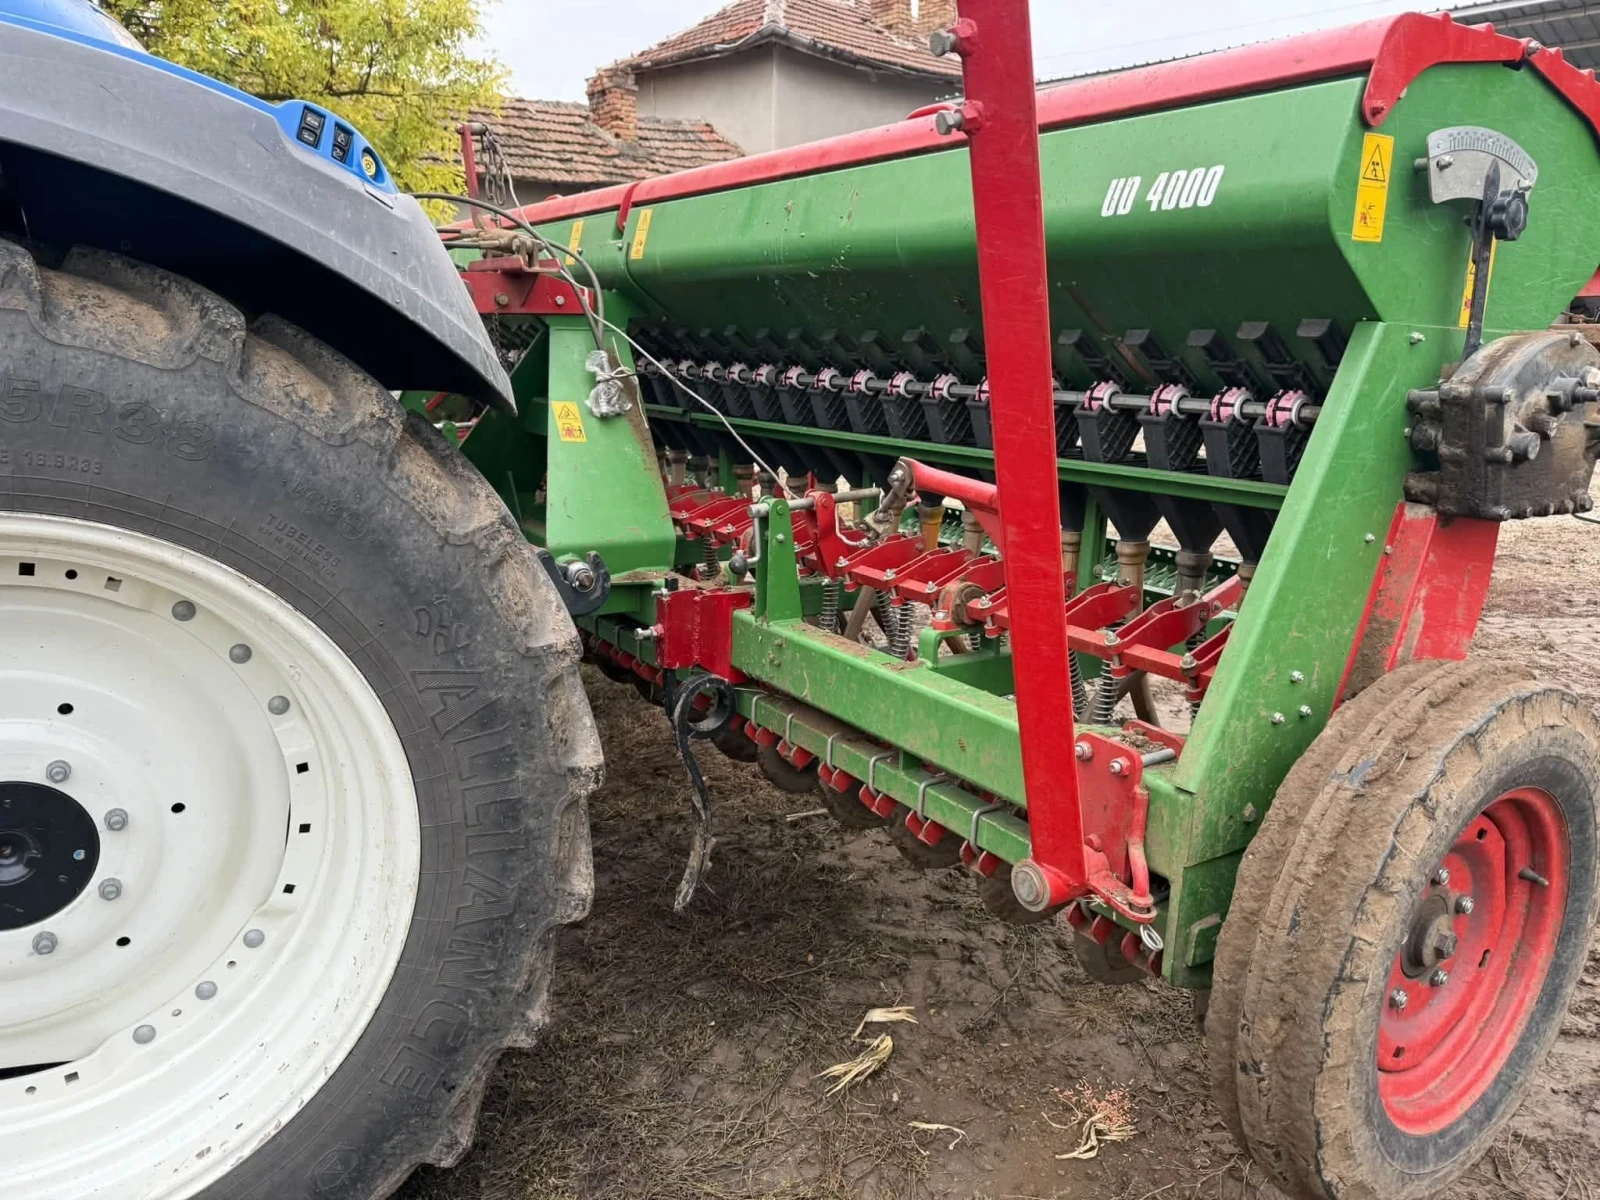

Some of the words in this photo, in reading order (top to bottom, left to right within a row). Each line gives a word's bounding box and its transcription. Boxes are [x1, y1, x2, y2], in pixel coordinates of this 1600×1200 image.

[1145, 164, 1225, 212] 4000
[264, 511, 342, 569] TUBELESS
[378, 667, 528, 1102] ALLIANCE
